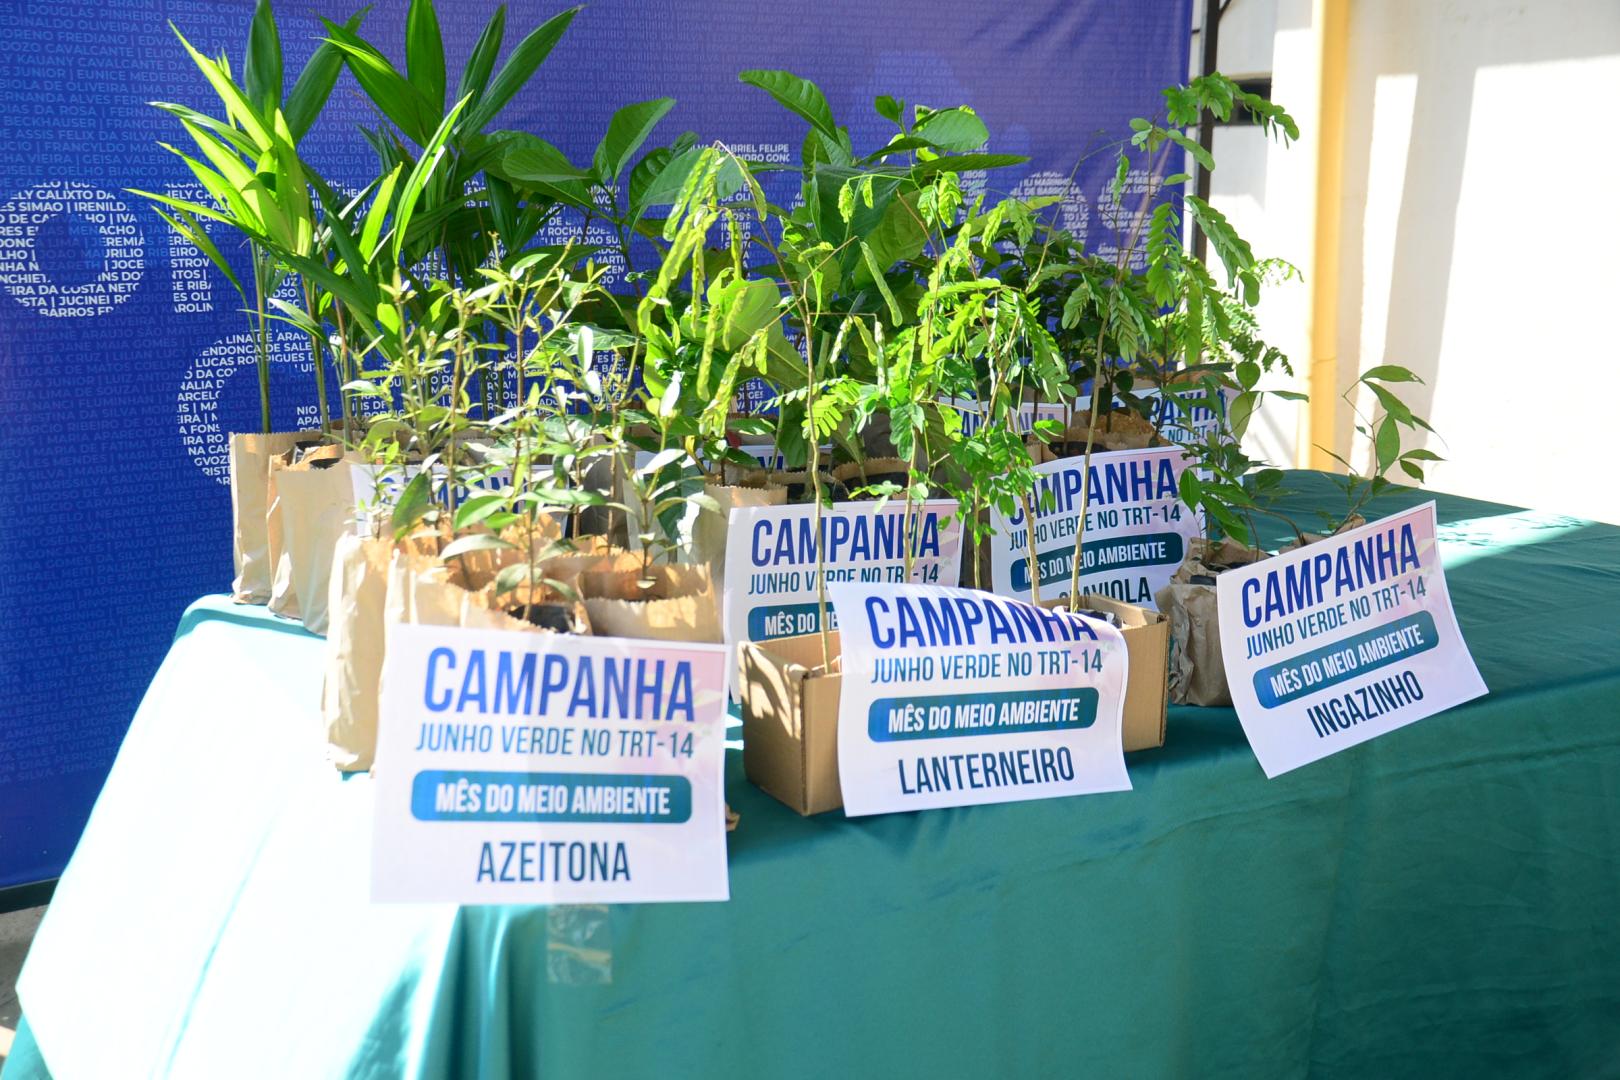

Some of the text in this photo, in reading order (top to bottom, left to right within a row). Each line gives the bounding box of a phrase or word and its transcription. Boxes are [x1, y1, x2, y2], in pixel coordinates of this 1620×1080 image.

[77, 20, 140, 32] OLIVEIRA
[66, 81, 128, 94] OLIVEIRA
[132, 83, 163, 94] LIMA
[759, 144, 789, 153] FELIPE
[547, 226, 583, 236] ROCHA
[195, 356, 234, 368] LUCAS
[1097, 508, 1118, 529] NO
[1122, 504, 1181, 526] TRT-14
[1049, 557, 1065, 578] DO
[1098, 541, 1166, 566] AMBIENTE
[1241, 522, 1420, 629] CAMPANHA
[748, 571, 799, 596] JUNHO
[886, 563, 939, 583] TR-14
[764, 610, 793, 636] MÊS
[797, 612, 816, 632] DO
[864, 595, 1099, 650] CAMPANHA
[1246, 575, 1427, 659] JUNHO VERDE NO TRT-14
[871, 648, 1104, 684] JUNHO VERDE NO TRT-14
[1270, 623, 1425, 698] MÊS DO MEIO AMBIENTE
[423, 646, 696, 722] CAMPANHA
[888, 698, 1081, 734] MÊS DO MEIO AMBIENTE
[1307, 669, 1425, 738] INGAZINHO
[415, 723, 695, 759] JUNHO VERDE NO TRT-14
[898, 746, 1075, 795] LANTERNEIRO
[435, 778, 671, 816] MÊS DO MEIO AMBIENTE
[476, 841, 632, 883] AZEITONA
